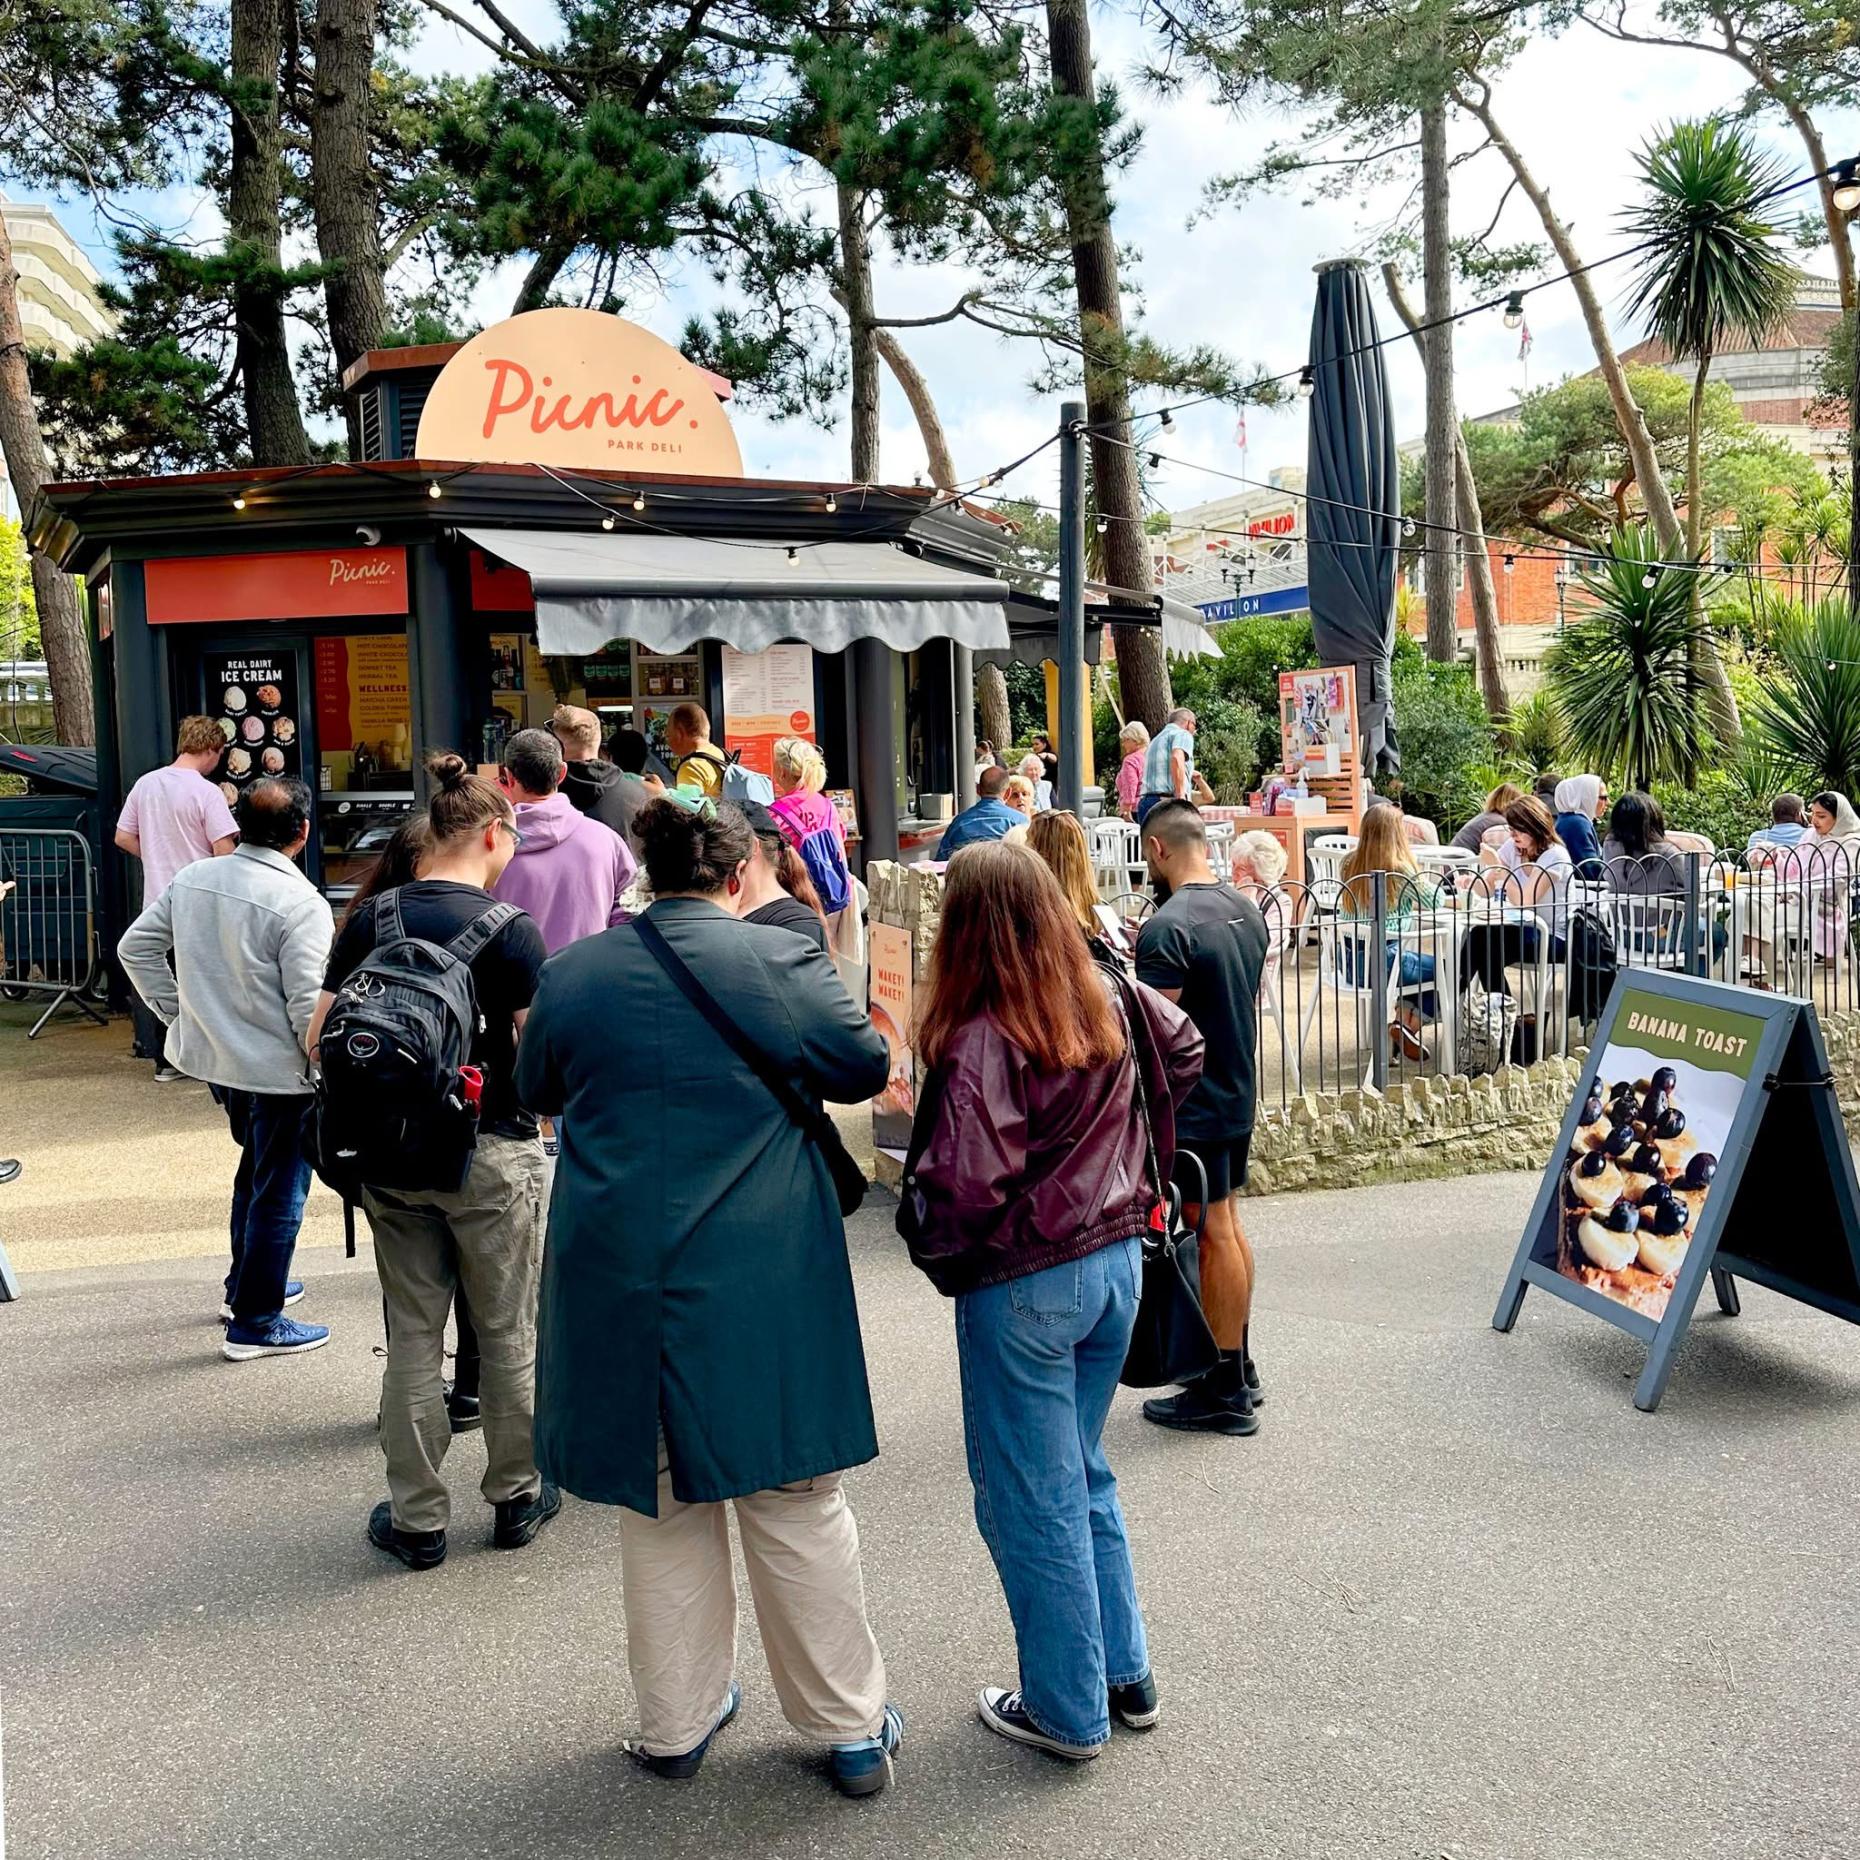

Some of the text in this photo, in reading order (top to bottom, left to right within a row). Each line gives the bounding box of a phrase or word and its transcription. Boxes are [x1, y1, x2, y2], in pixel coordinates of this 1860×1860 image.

[483, 359, 698, 439] Picnic.
[607, 439, 683, 453] PARK DELI
[1201, 599, 1259, 619] AVILON
[227, 659, 272, 669] REAL DAIRY
[221, 669, 282, 682] ICE CREAM
[878, 968, 905, 987] WAKEY!
[878, 983, 905, 1003] WAKEY!
[1627, 1011, 1747, 1057] BANANA TOAST
